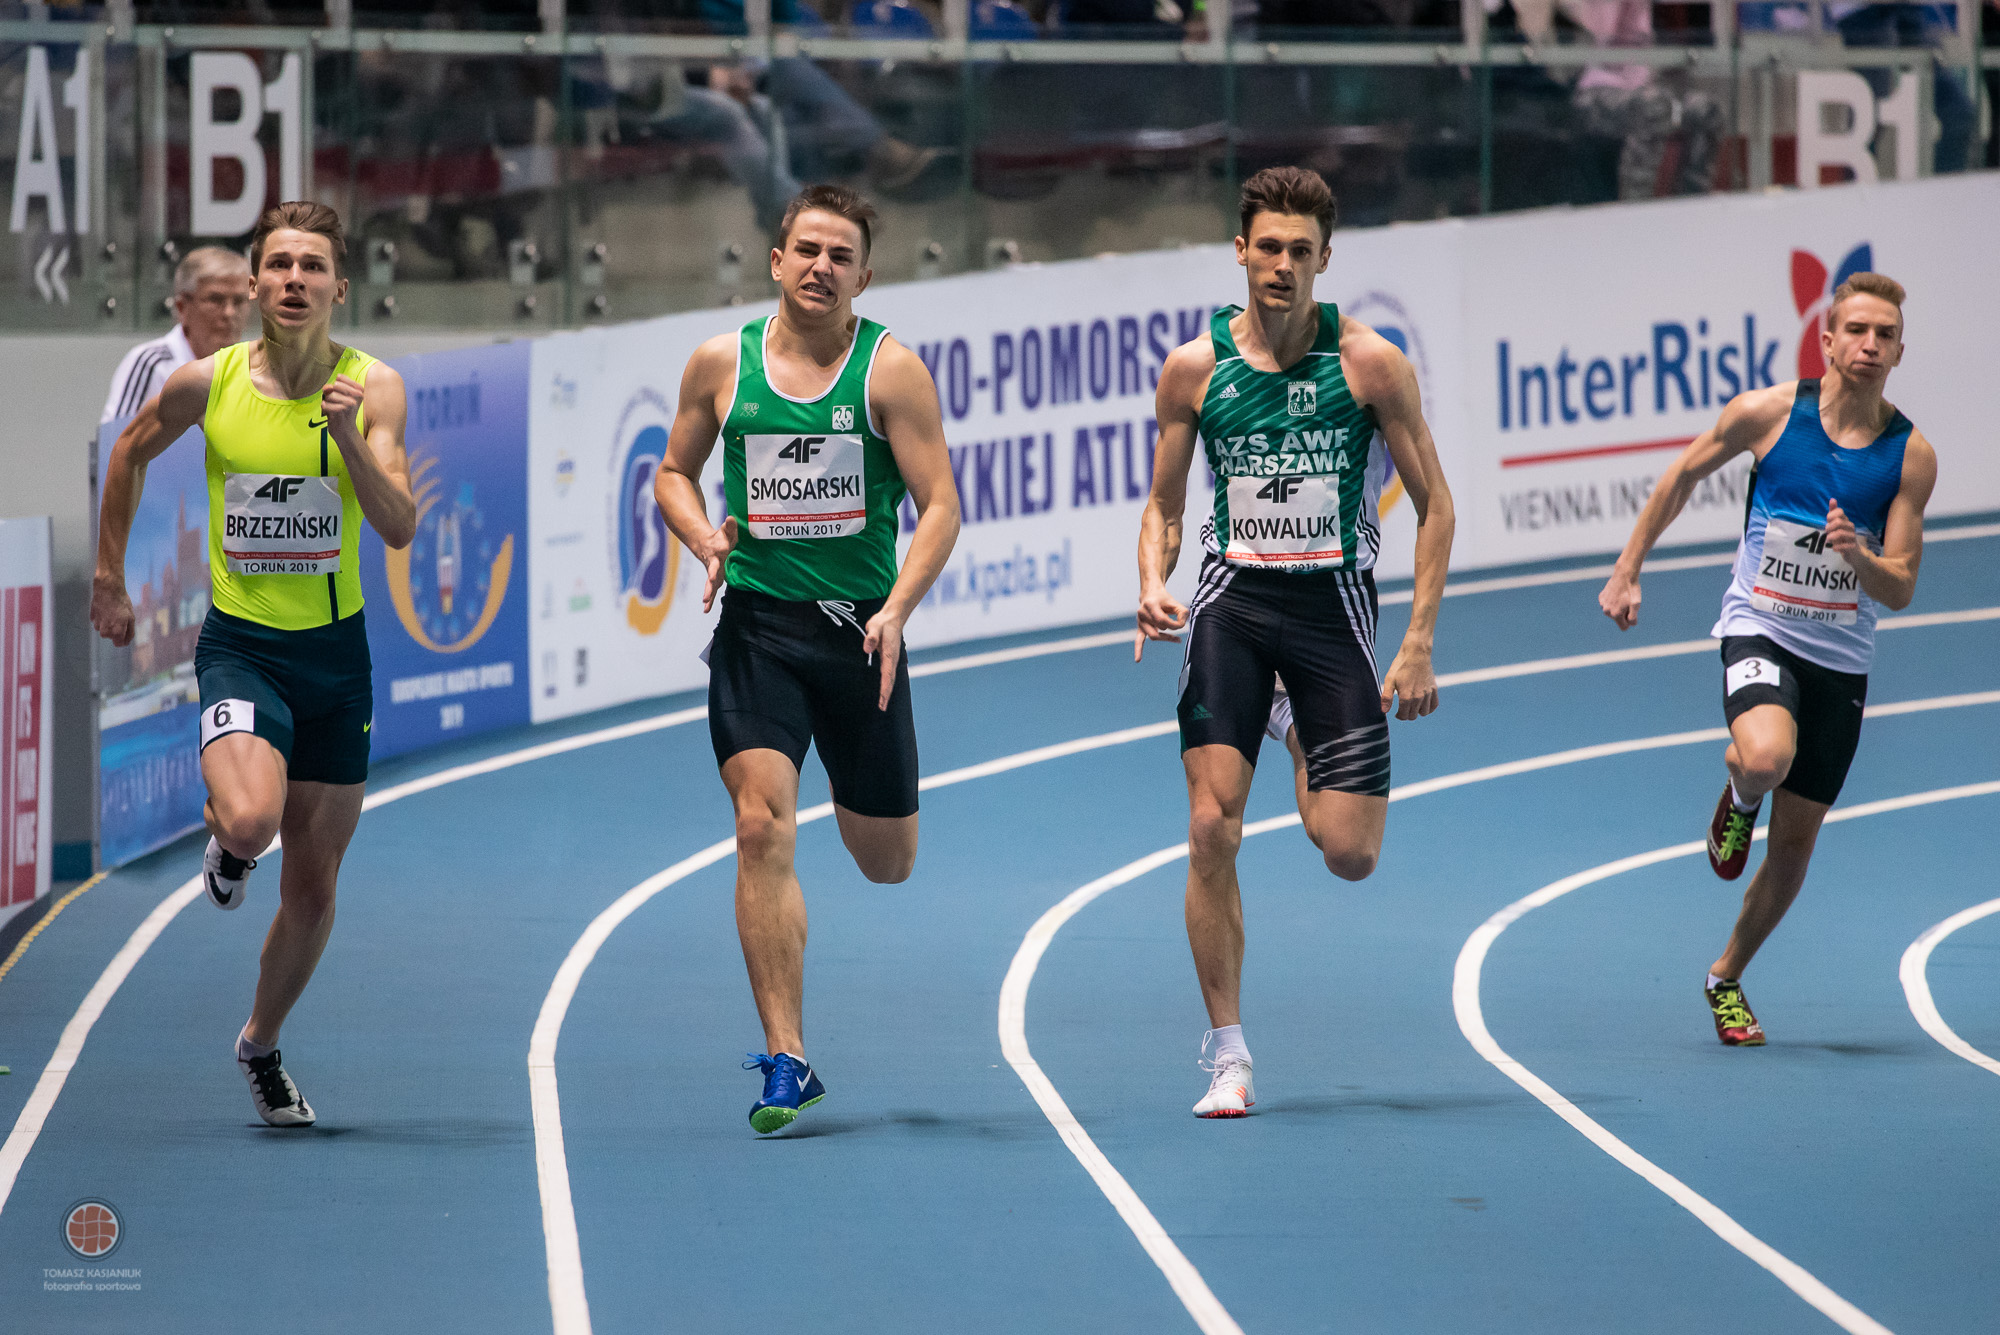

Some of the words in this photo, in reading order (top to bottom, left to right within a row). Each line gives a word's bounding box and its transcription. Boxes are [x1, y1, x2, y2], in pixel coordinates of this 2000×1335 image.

[10, 46, 90, 234] A1
[1798, 70, 1918, 188] B1
[189, 51, 302, 237] B1
[1497, 312, 1779, 431] InterRisk
[778, 437, 826, 463] 4F
[1214, 433, 1270, 457] AZS
[1280, 427, 1350, 452] AWF
[254, 476, 306, 503] 4F
[751, 474, 860, 501] SMOSARSKI
[1256, 477, 1304, 503] 4F
[226, 512, 338, 539] BRZEZIŃSKI
[769, 523, 809, 536] TORUŃ
[813, 524, 842, 535] 2019
[1232, 515, 1336, 540] KOWALUK
[244, 559, 286, 573] TORUŃ
[289, 563, 318, 573] 2019
[1761, 556, 1858, 591] ZIELIŃSKI
[1811, 611, 1837, 622] 2019
[1744, 659, 1762, 679] 3
